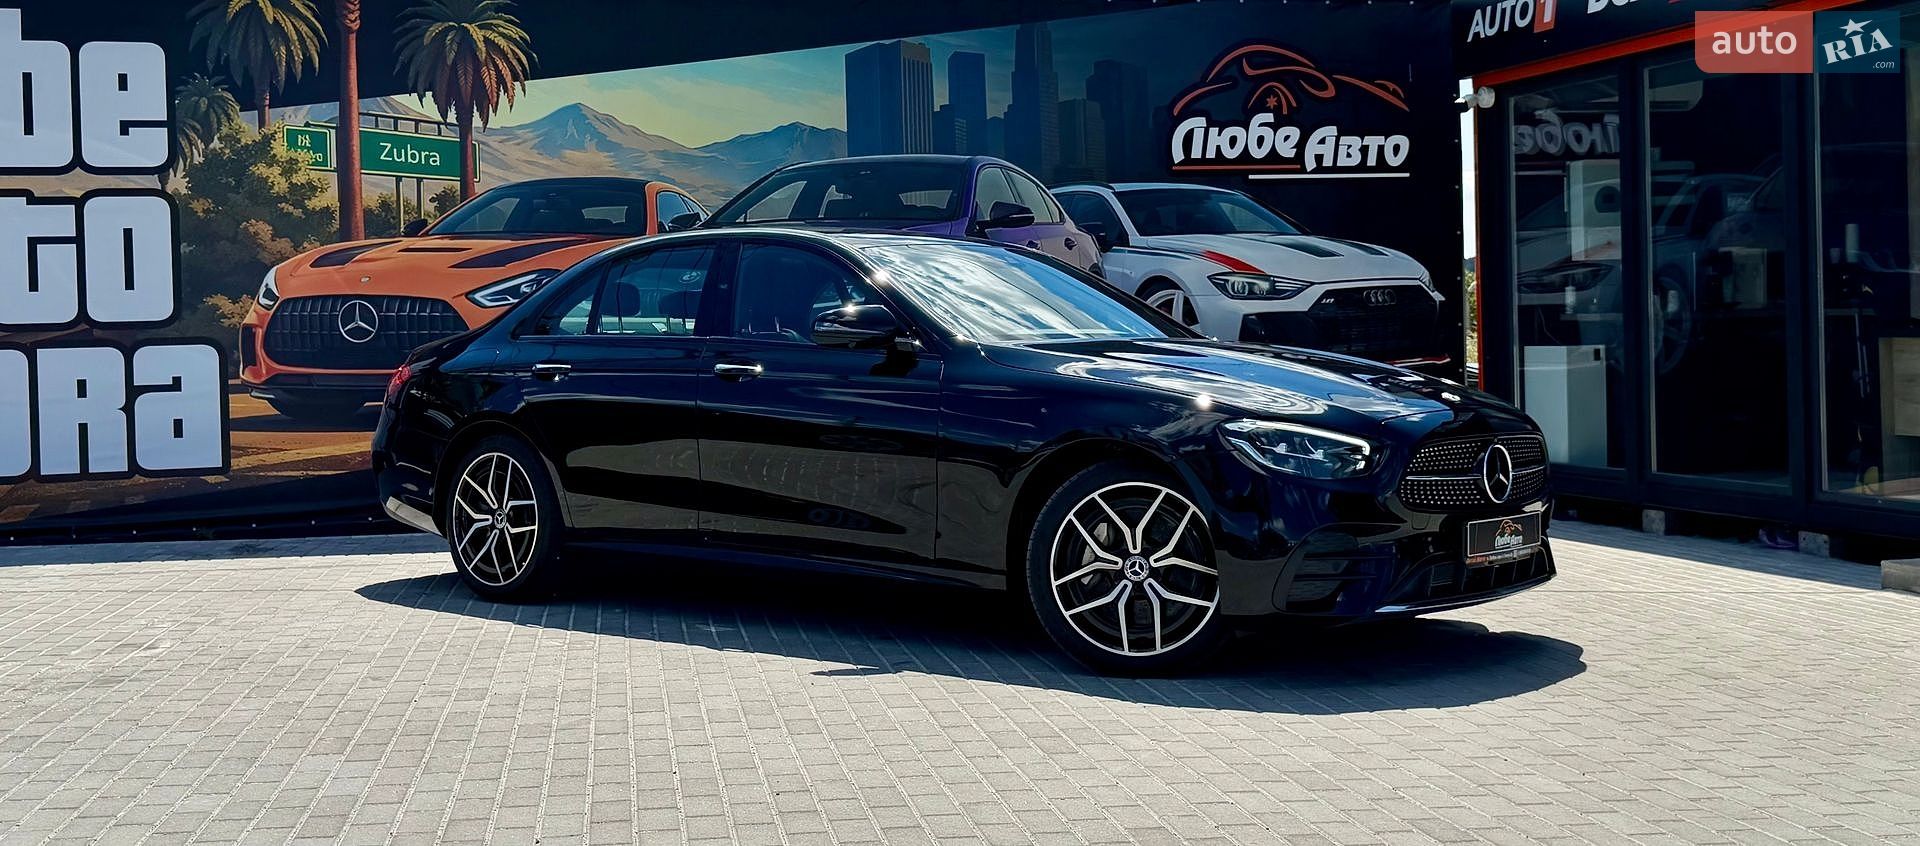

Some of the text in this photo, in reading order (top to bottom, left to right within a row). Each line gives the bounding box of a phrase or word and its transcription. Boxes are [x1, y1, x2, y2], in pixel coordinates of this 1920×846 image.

[379, 142, 440, 166] Zubra
[1171, 113, 1410, 172] Любе Авто
